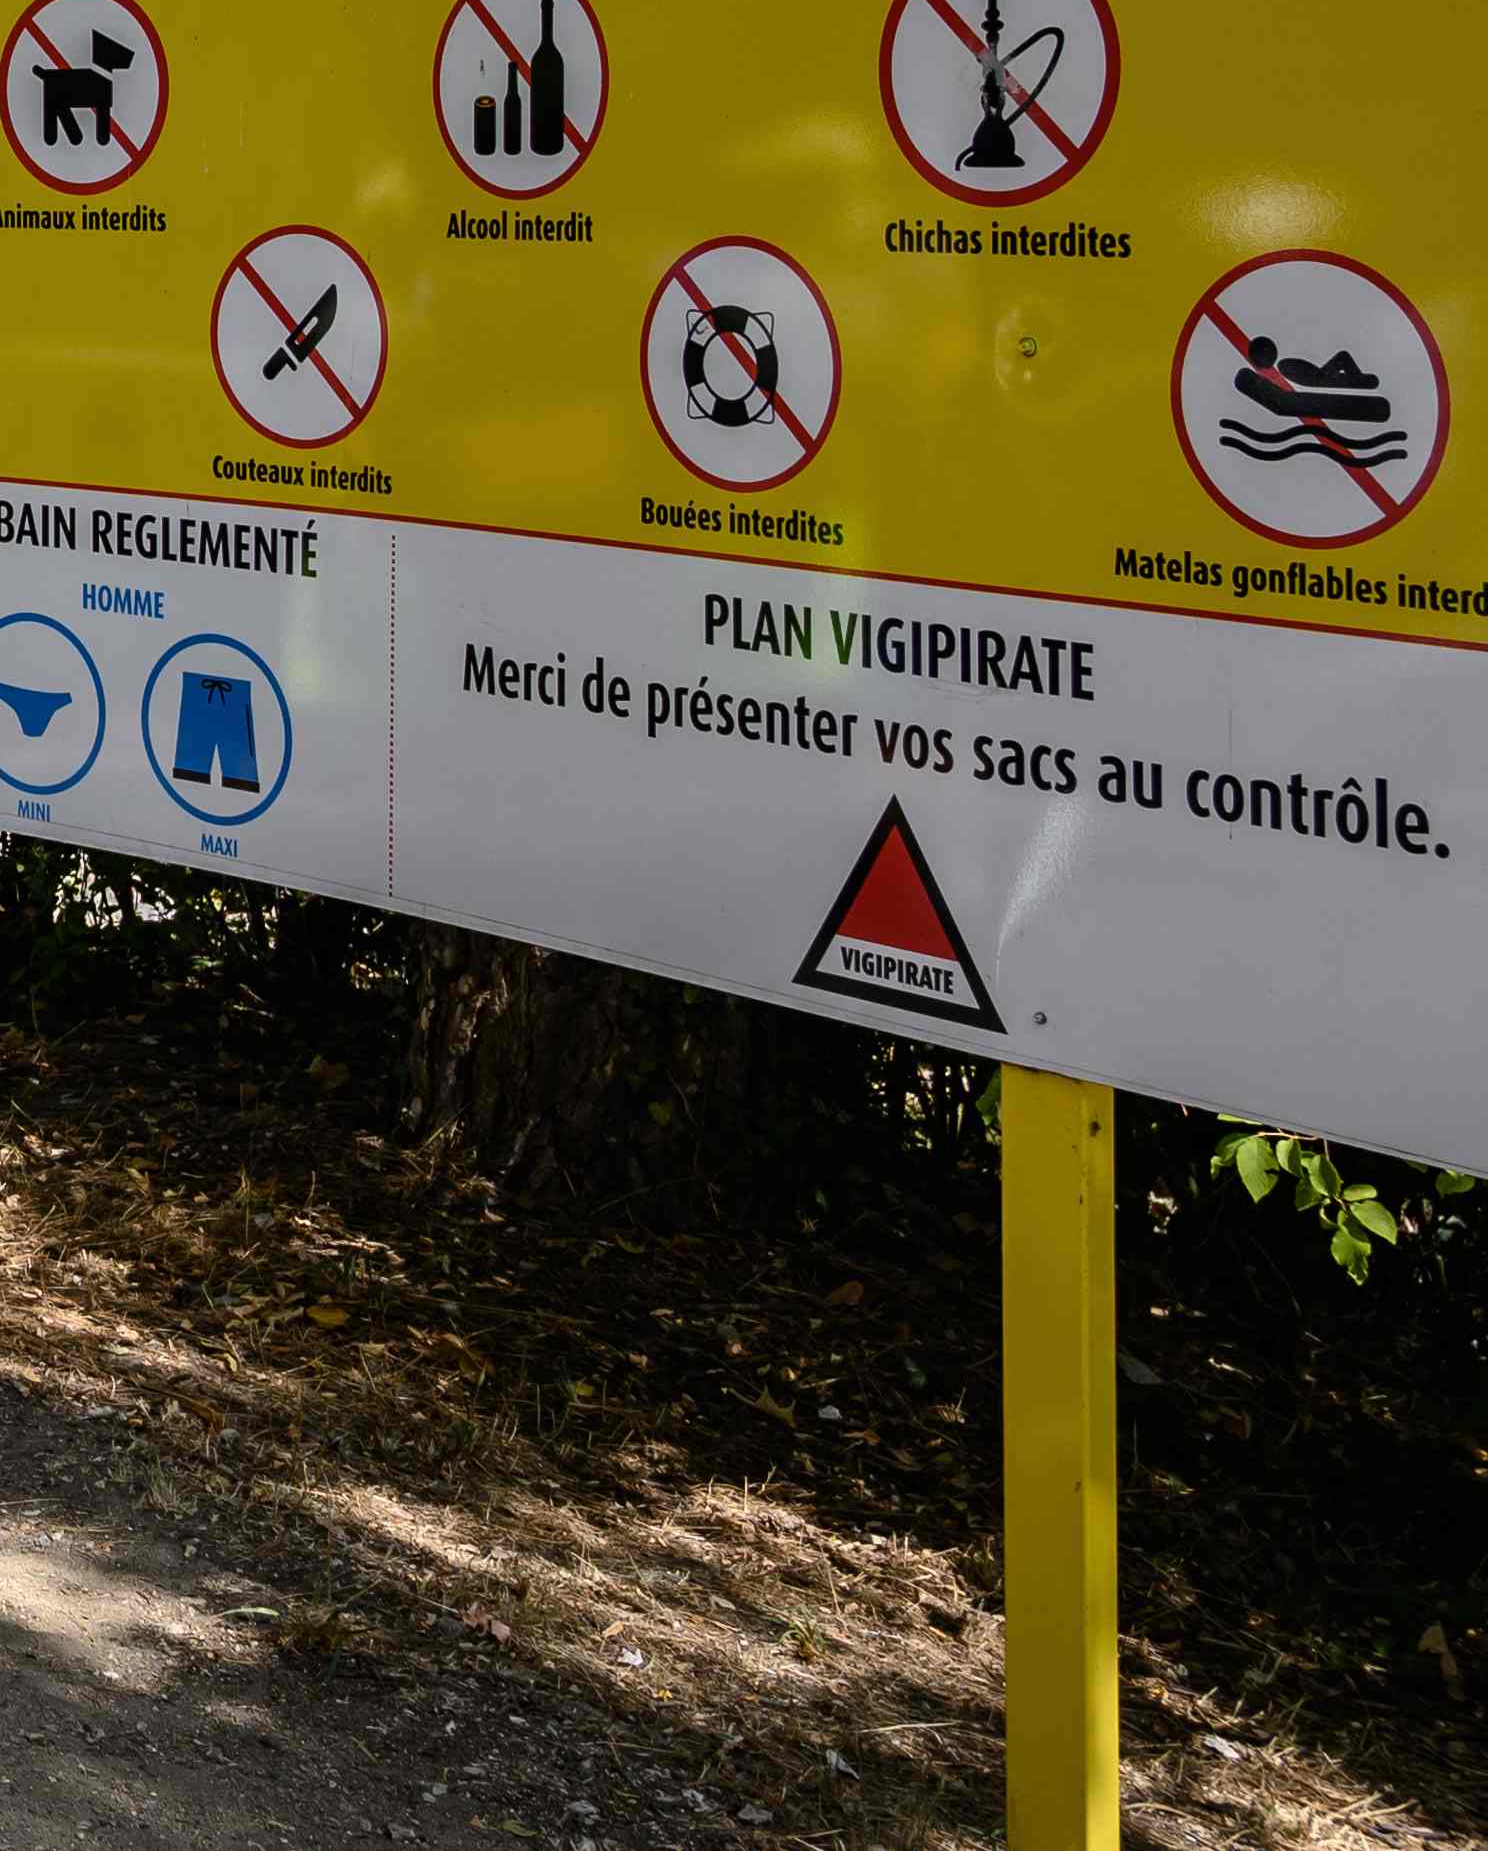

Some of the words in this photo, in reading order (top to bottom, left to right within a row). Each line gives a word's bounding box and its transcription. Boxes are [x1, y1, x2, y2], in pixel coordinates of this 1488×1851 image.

[81, 203, 167, 233] interdits
[447, 210, 507, 240] Alcool
[515, 211, 592, 242] interdit
[885, 221, 983, 256] Chichas
[991, 222, 1132, 259] interdites
[212, 455, 305, 487] Couteaux
[310, 461, 393, 495] interdits
[640, 496, 722, 535] Bouées
[728, 504, 843, 546] interdites
[92, 508, 317, 577] REGLEMENTÉ
[1115, 548, 1222, 586] Matelas
[1232, 562, 1386, 605] gonflables
[81, 584, 164, 620] HOMME
[705, 593, 814, 660] PLAN
[830, 610, 1094, 701] VIGIPIRATE
[463, 644, 566, 708] Merci
[582, 658, 631, 720] de
[647, 676, 858, 755] présenter
[875, 718, 954, 773] vos
[973, 733, 1076, 795] sacs
[1098, 754, 1162, 810] au
[1186, 768, 1451, 859] contrôle.
[16, 798, 51, 823] MINI
[201, 832, 238, 859] MAXI
[840, 946, 954, 994] VIGIPIRATE
